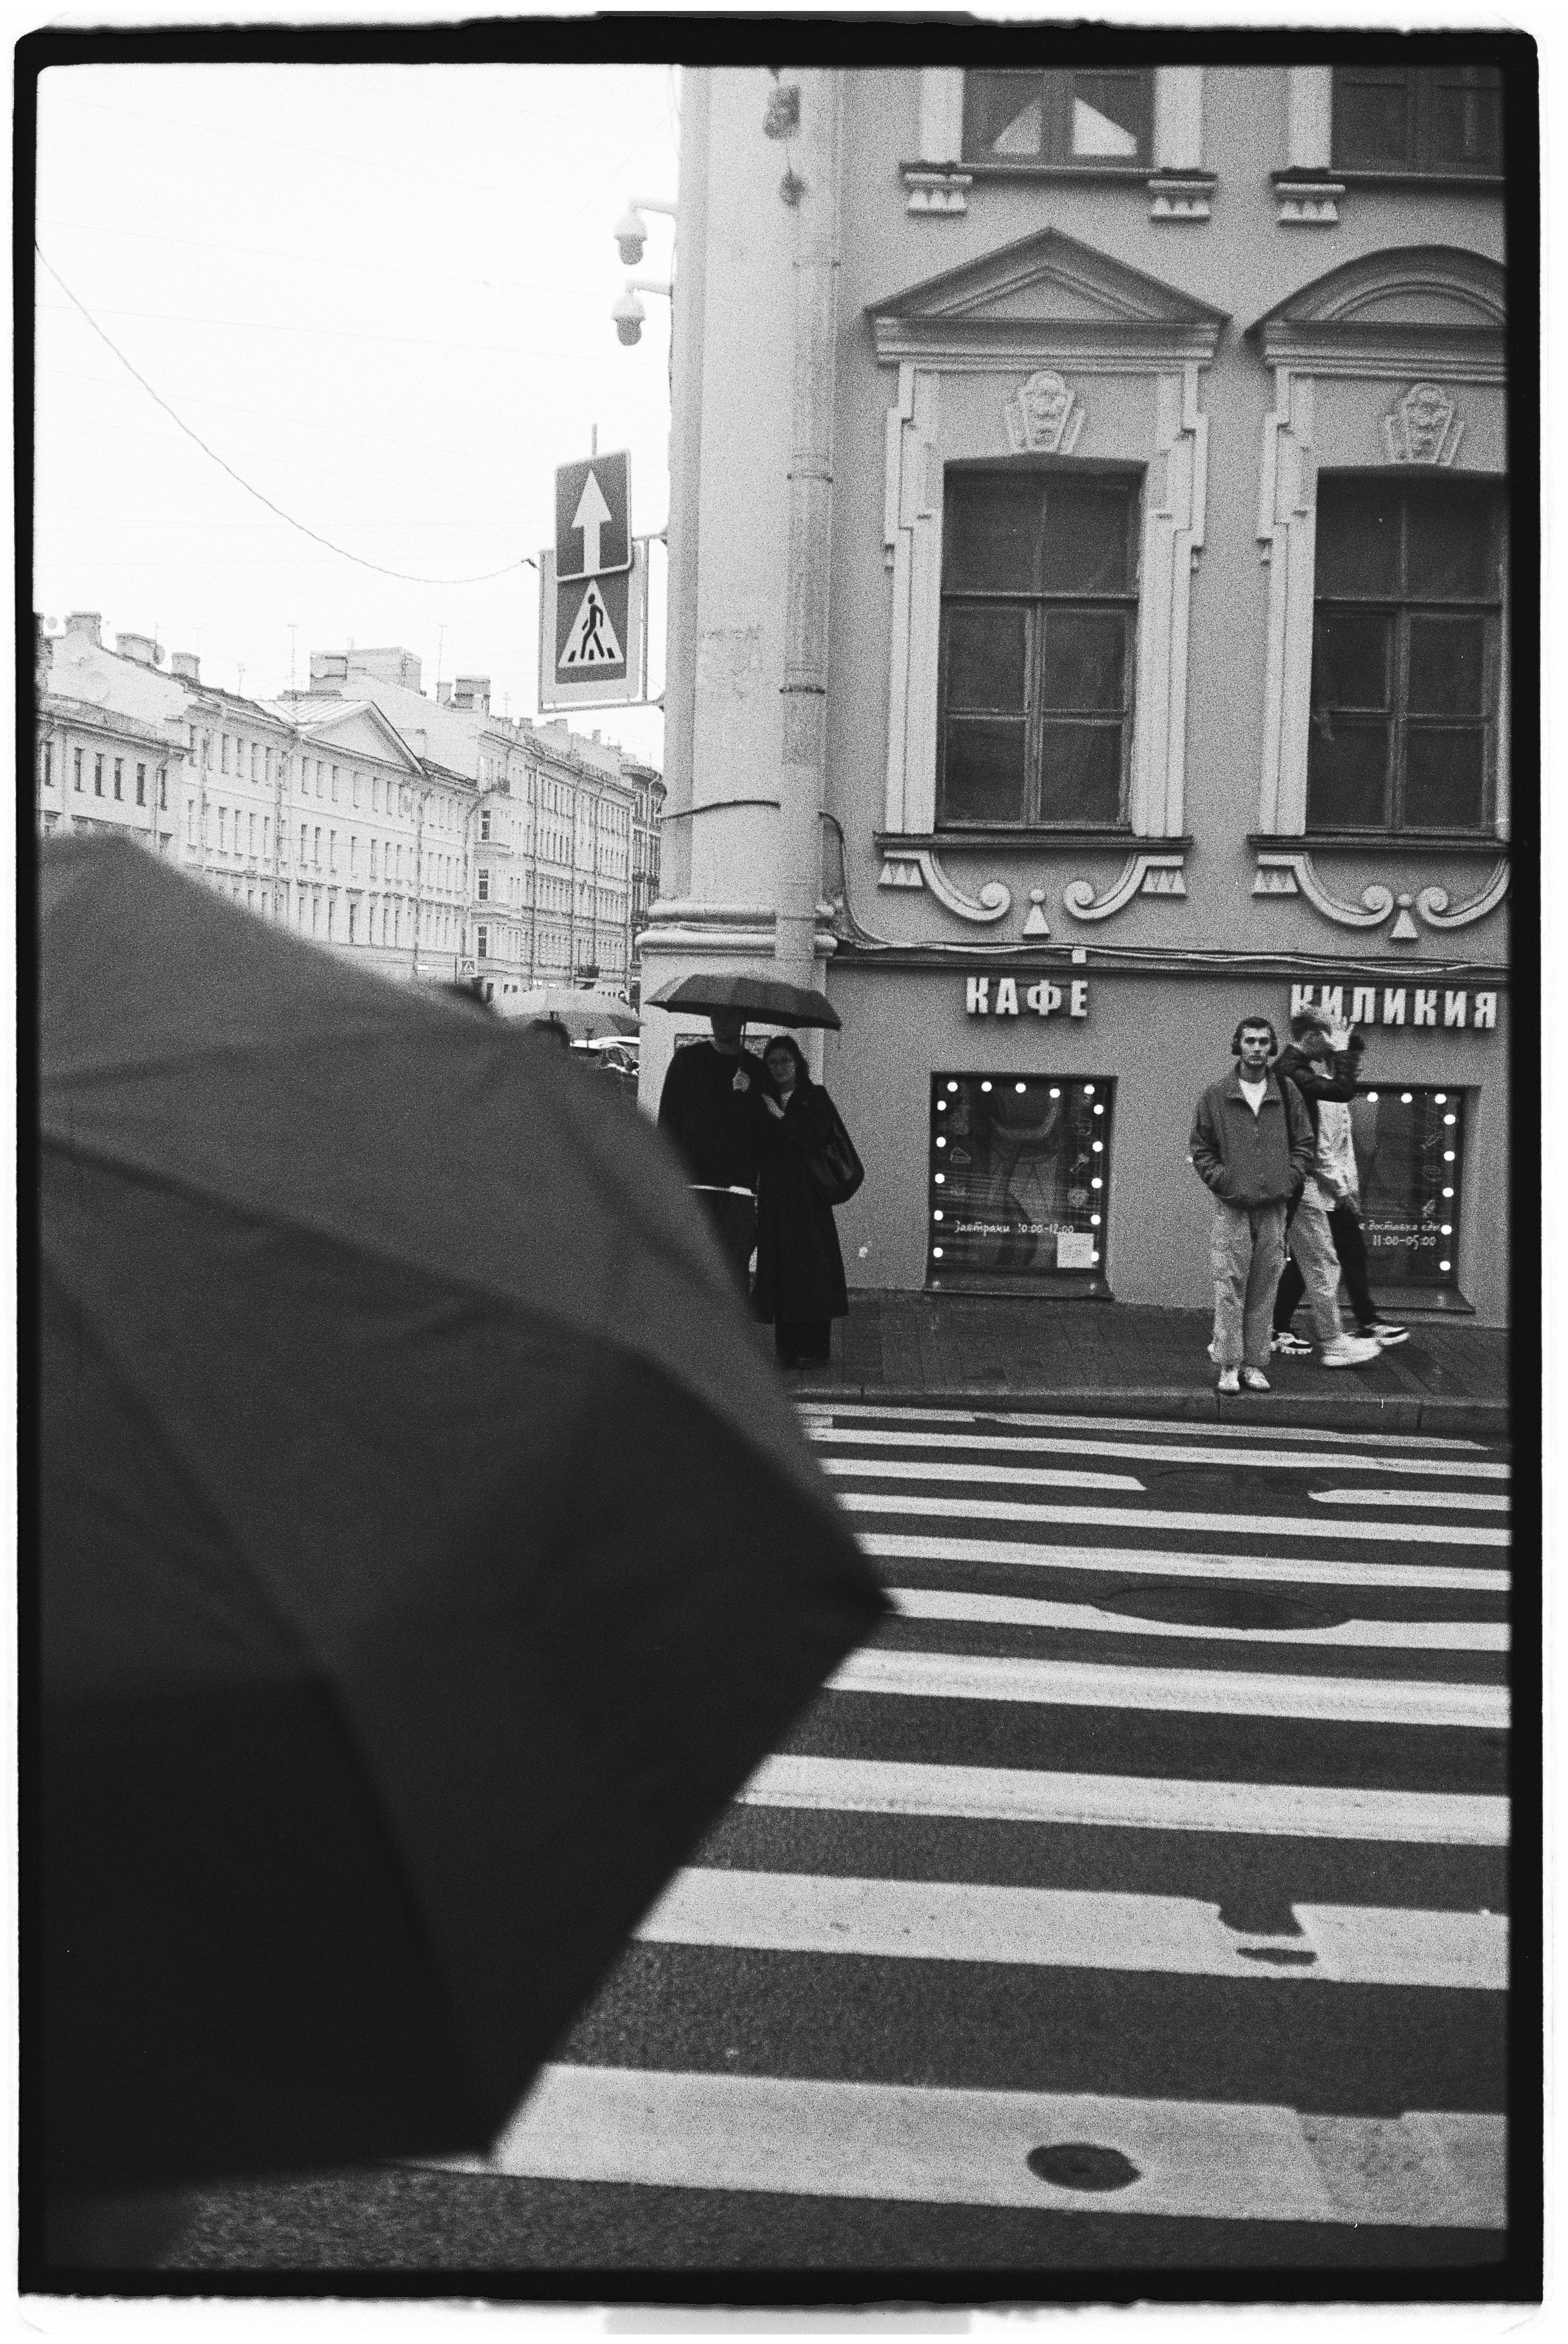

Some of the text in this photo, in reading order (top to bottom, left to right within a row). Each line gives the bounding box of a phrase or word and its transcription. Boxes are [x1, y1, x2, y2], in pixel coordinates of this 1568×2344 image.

[967, 976, 1089, 1017] КАФЕ
[1290, 983, 1497, 1028] КИЛИКИЯ
[954, 1219, 1011, 1237] Завтраки
